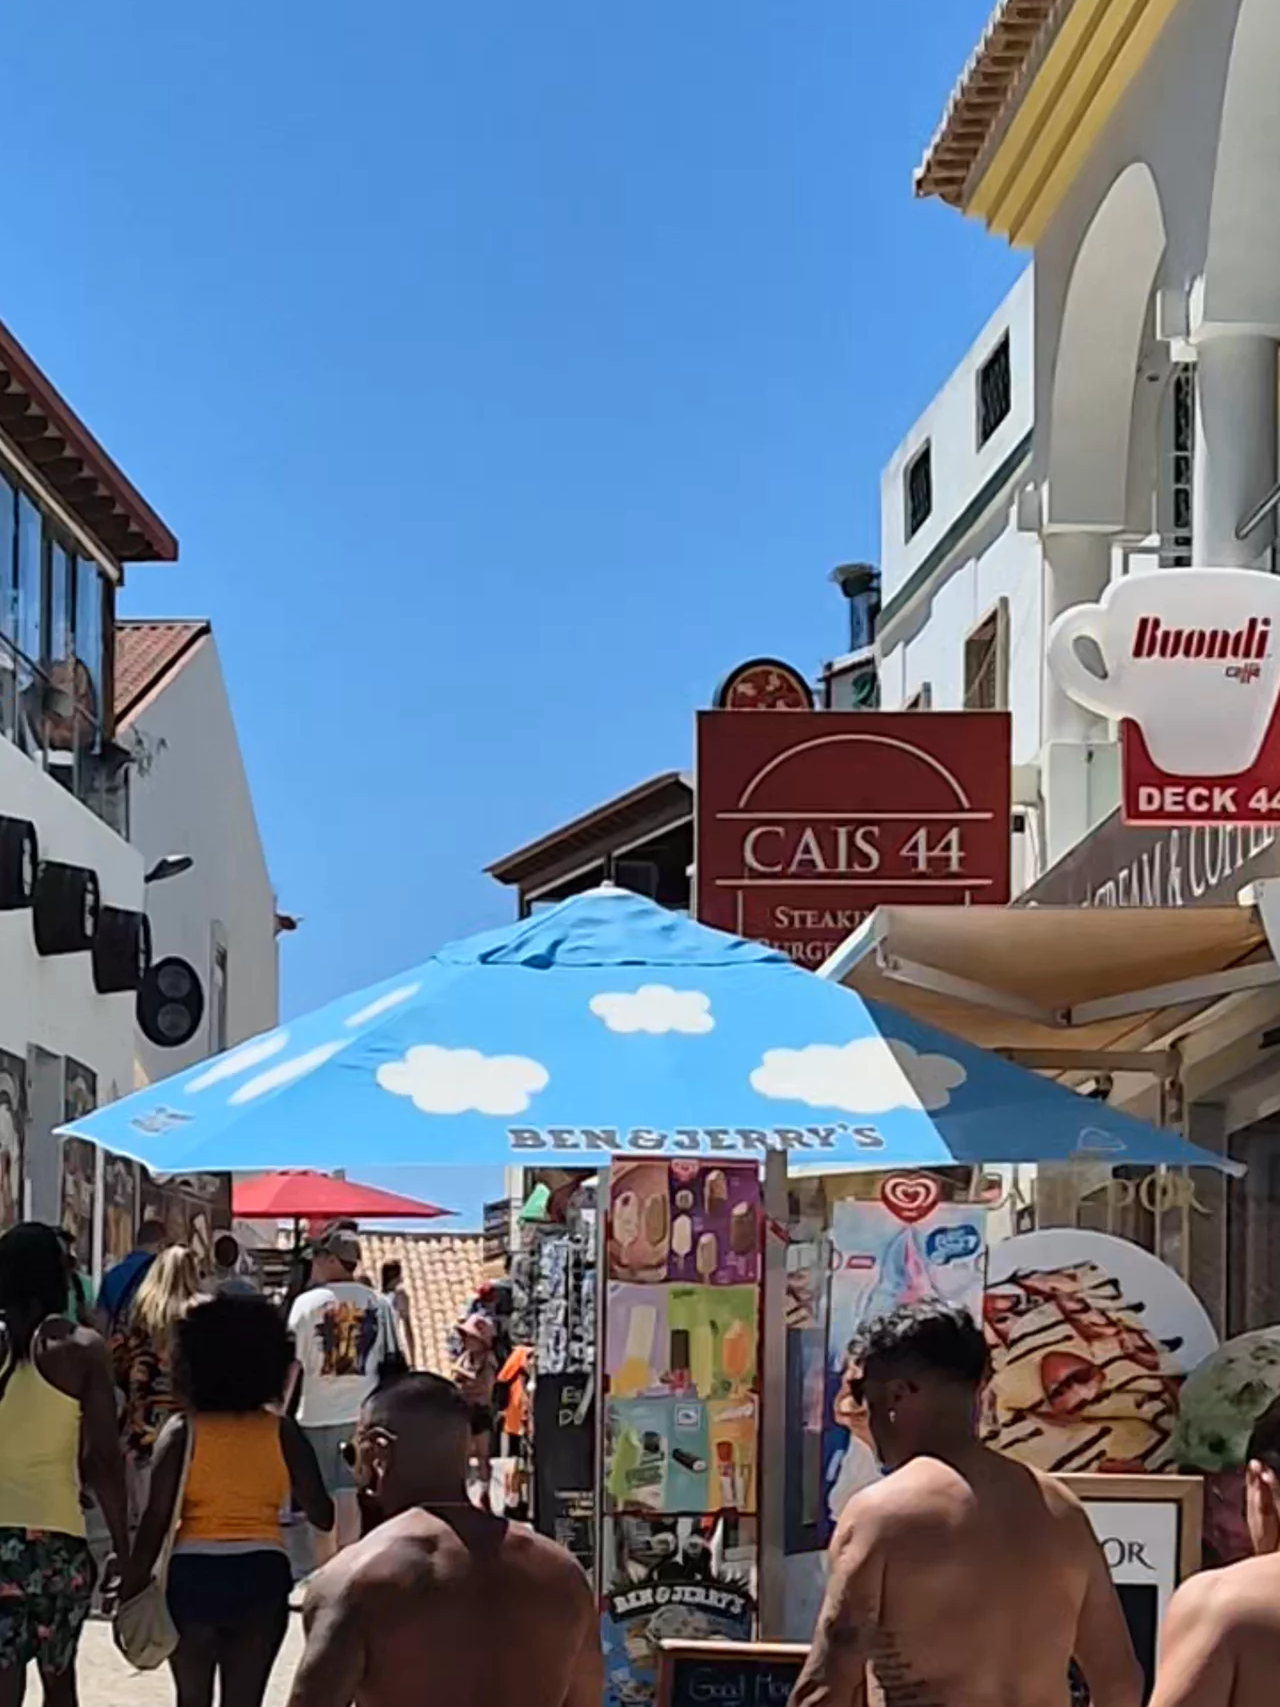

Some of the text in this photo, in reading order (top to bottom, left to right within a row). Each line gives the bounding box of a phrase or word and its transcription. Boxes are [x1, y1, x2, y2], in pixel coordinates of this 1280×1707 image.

[1132, 616, 1271, 659] Buondi
[1138, 786, 1237, 812] DECK
[743, 825, 966, 873] CAIS 44
